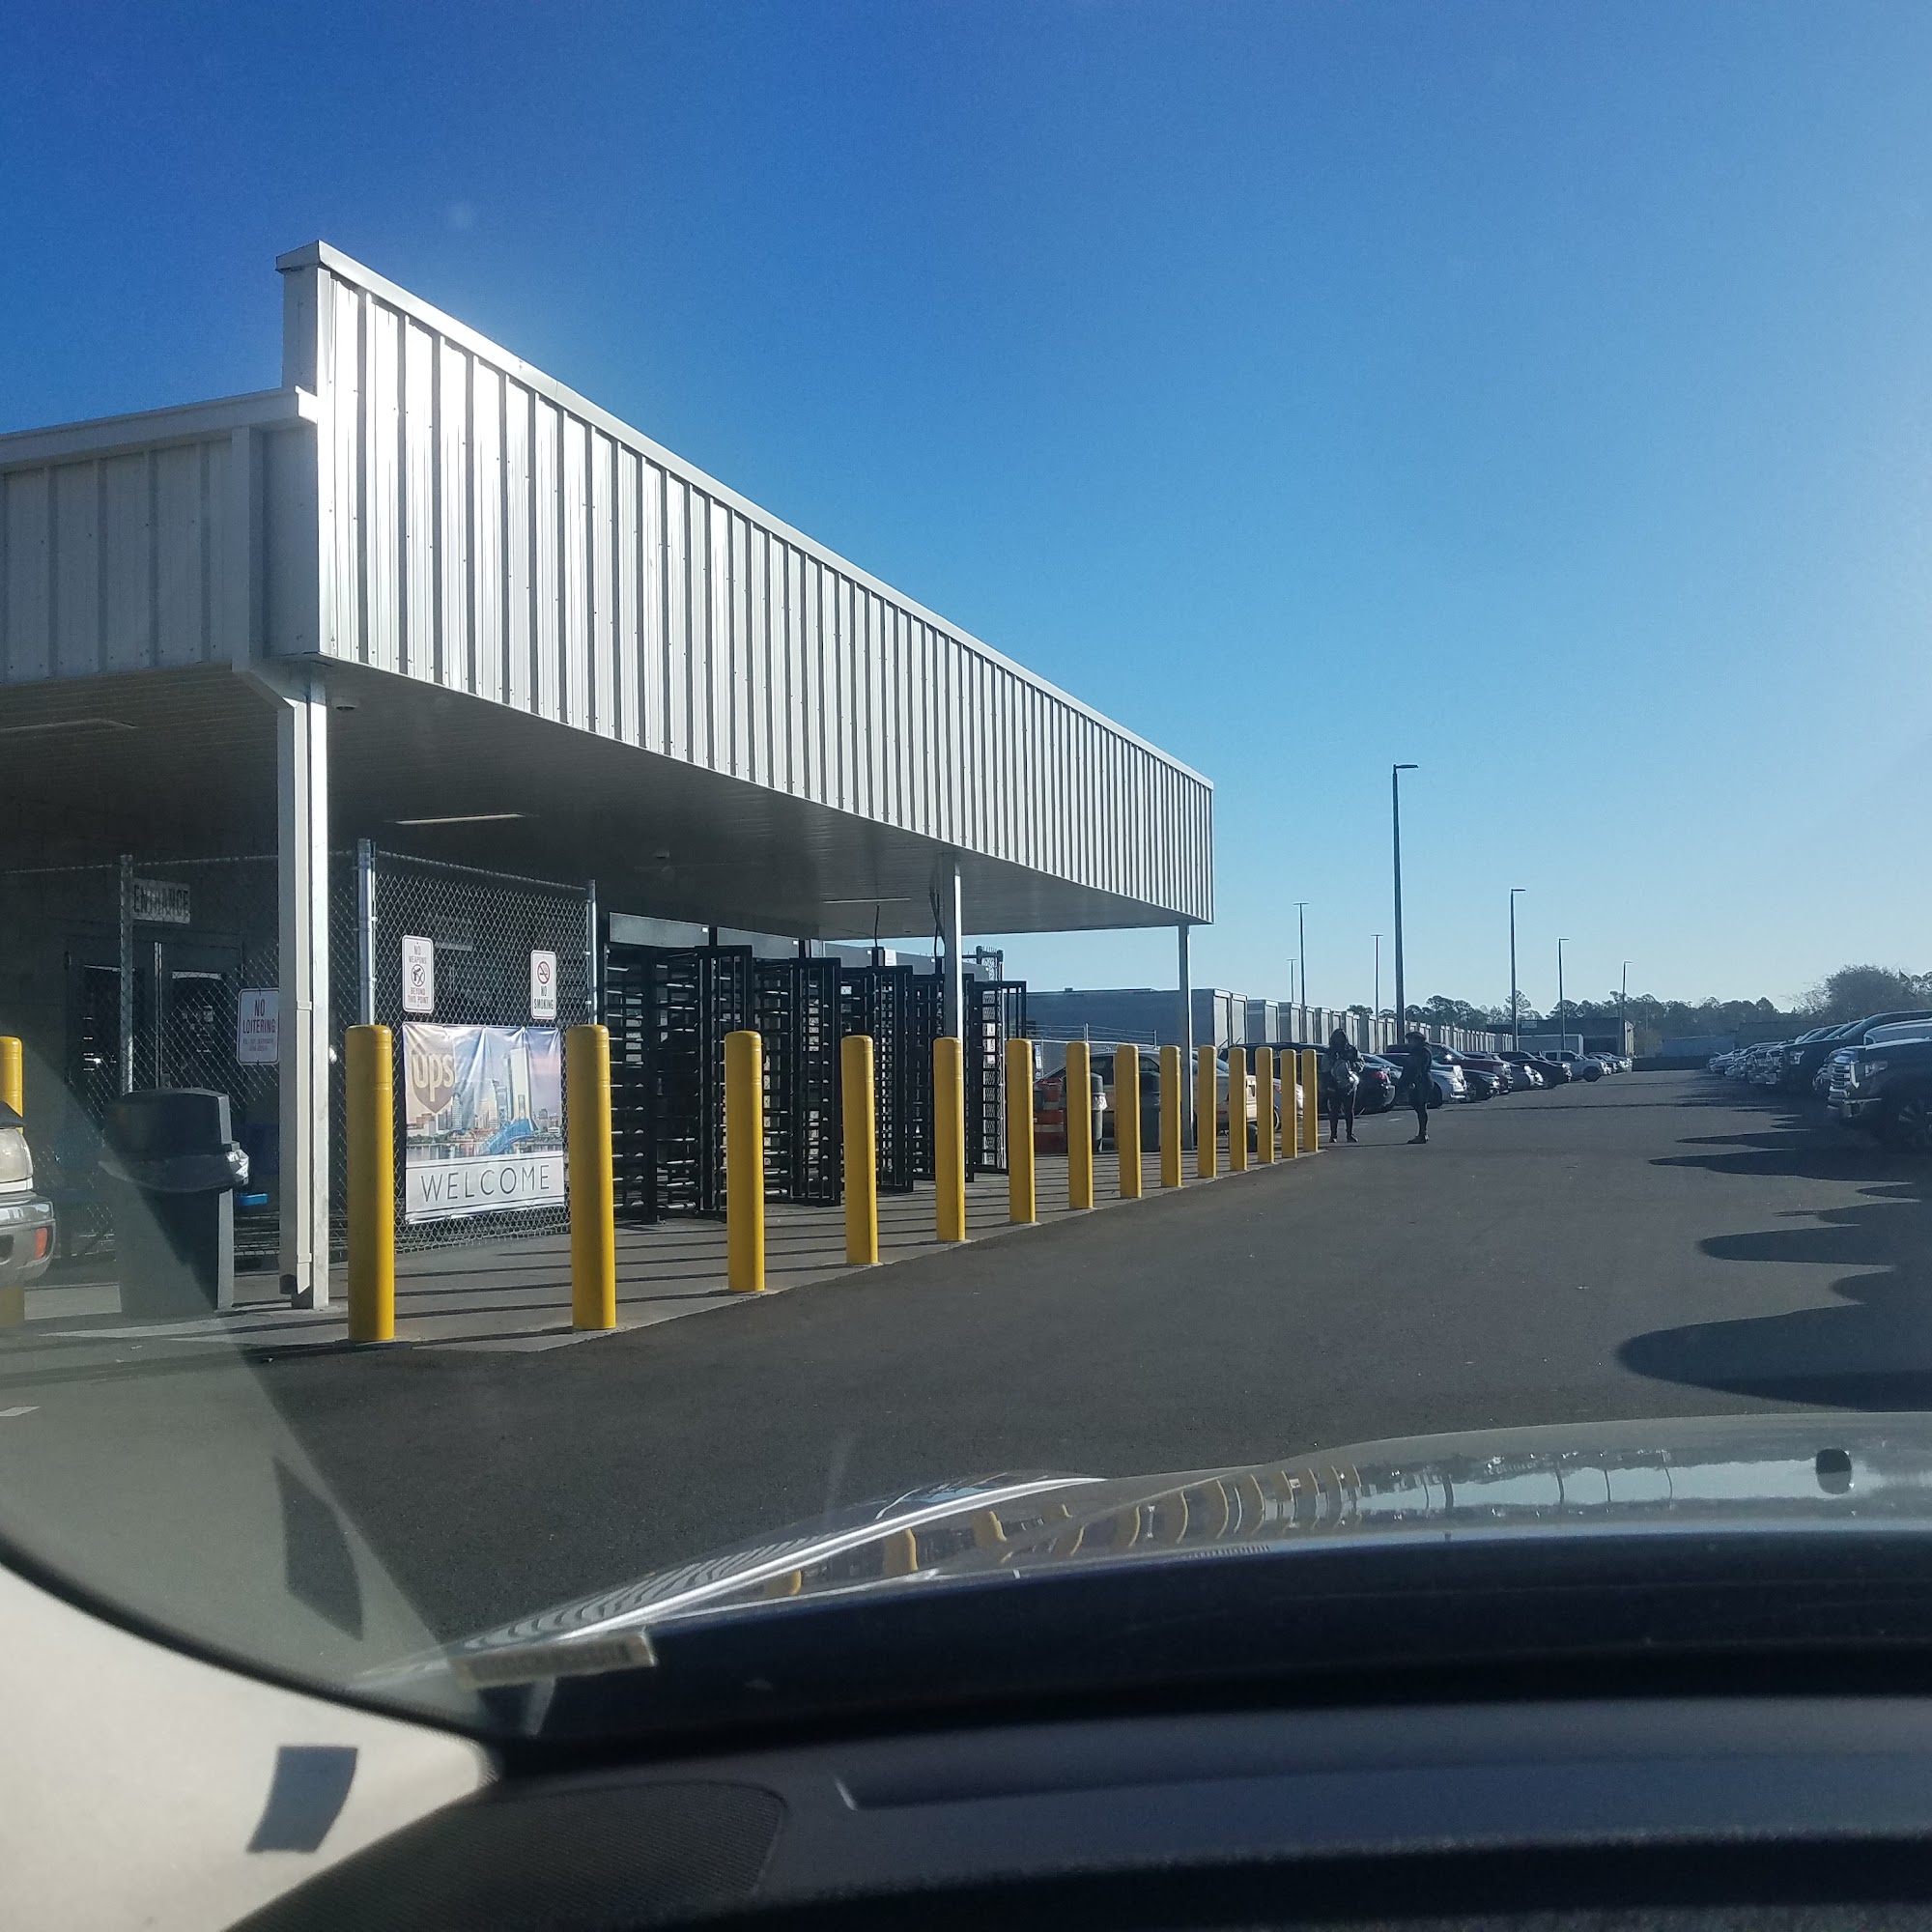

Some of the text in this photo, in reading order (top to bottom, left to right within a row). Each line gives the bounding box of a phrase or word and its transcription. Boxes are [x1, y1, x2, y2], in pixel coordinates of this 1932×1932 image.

[133, 885, 188, 918] ENTRANCE
[413, 946, 421, 955] NO
[540, 985, 548, 997] NO
[254, 999, 266, 1017] NO
[533, 998, 554, 1010] SMOKING
[242, 1019, 276, 1034] LOITERING
[421, 1165, 550, 1202] WELCOME
